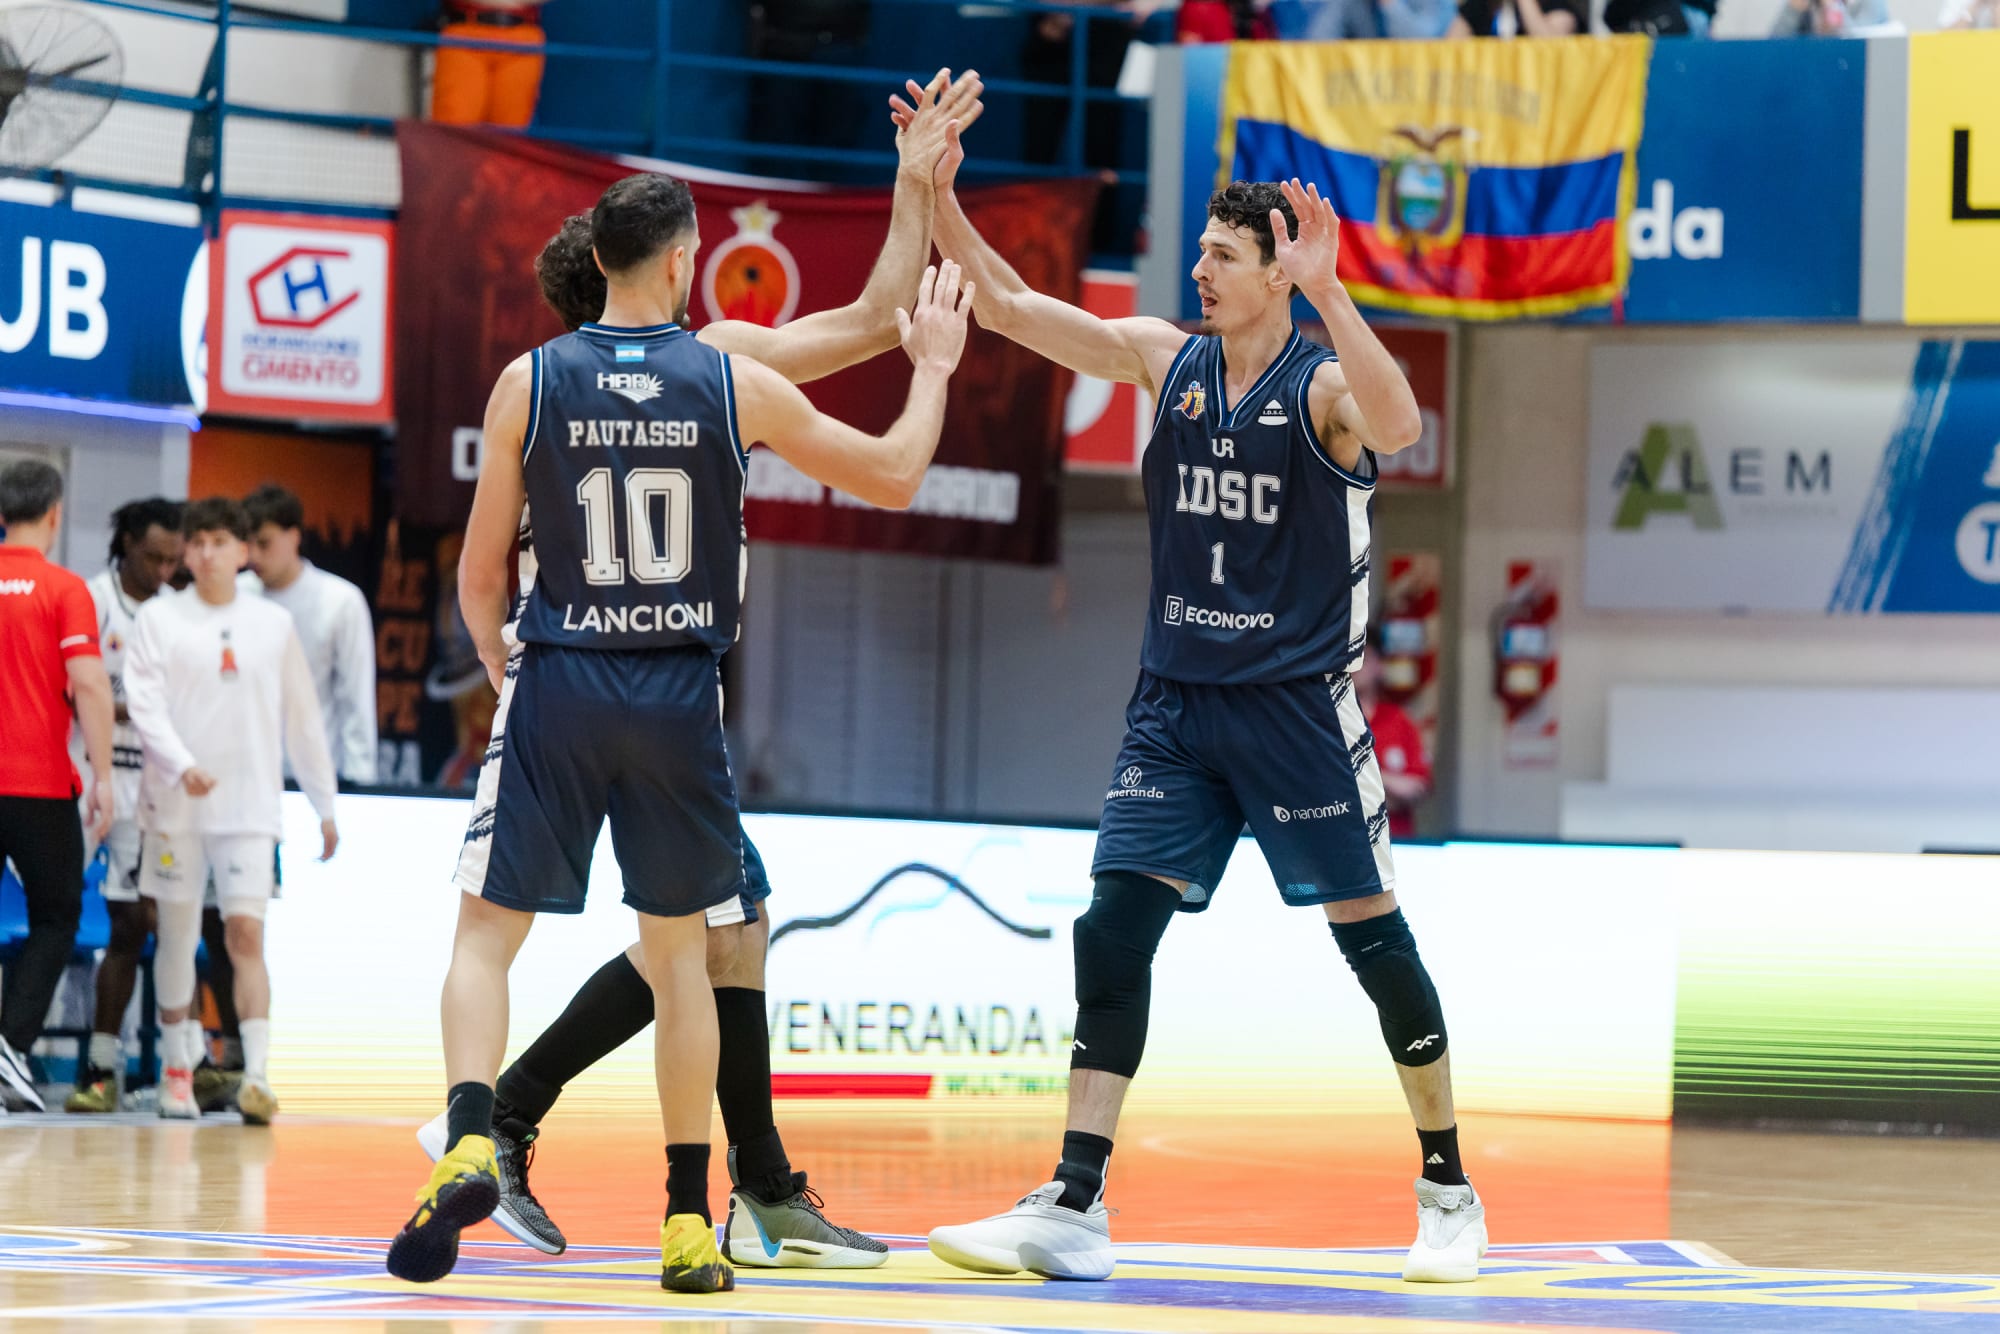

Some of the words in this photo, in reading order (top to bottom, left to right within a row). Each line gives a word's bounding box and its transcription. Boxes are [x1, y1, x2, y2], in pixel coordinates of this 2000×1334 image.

[567, 419, 699, 448] PAUTASSO
[1212, 437, 1235, 459] UR
[1175, 463, 1281, 525] IDSC
[576, 467, 693, 586] 10
[1210, 541, 1225, 585] 1
[562, 600, 714, 634] LANCIONI
[1185, 605, 1275, 630] ECONOVO
[1292, 801, 1350, 820] nanomix
